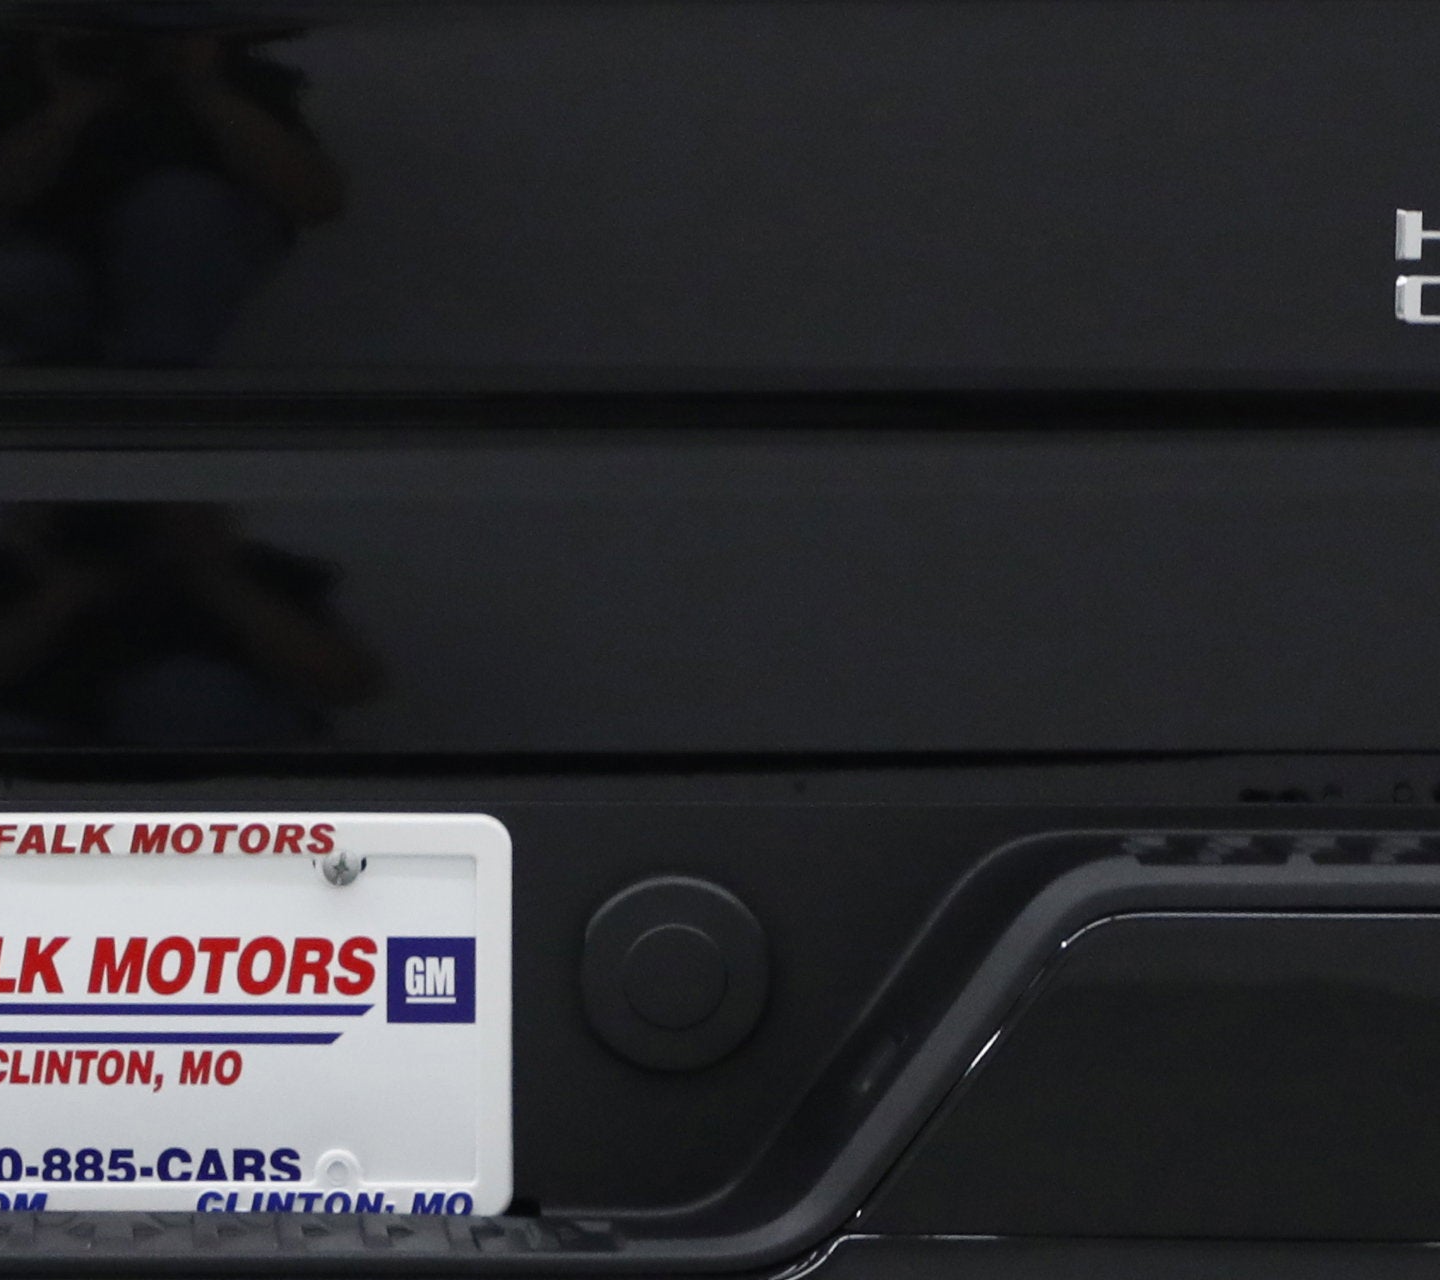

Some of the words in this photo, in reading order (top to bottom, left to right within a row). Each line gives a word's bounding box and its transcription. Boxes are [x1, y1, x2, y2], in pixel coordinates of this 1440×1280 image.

[130, 823, 335, 855] MOTORS
[88, 936, 378, 996] MOTORS
[405, 955, 457, 997] GM
[179, 1049, 243, 1087] MO
[411, 1191, 474, 1217] MO
